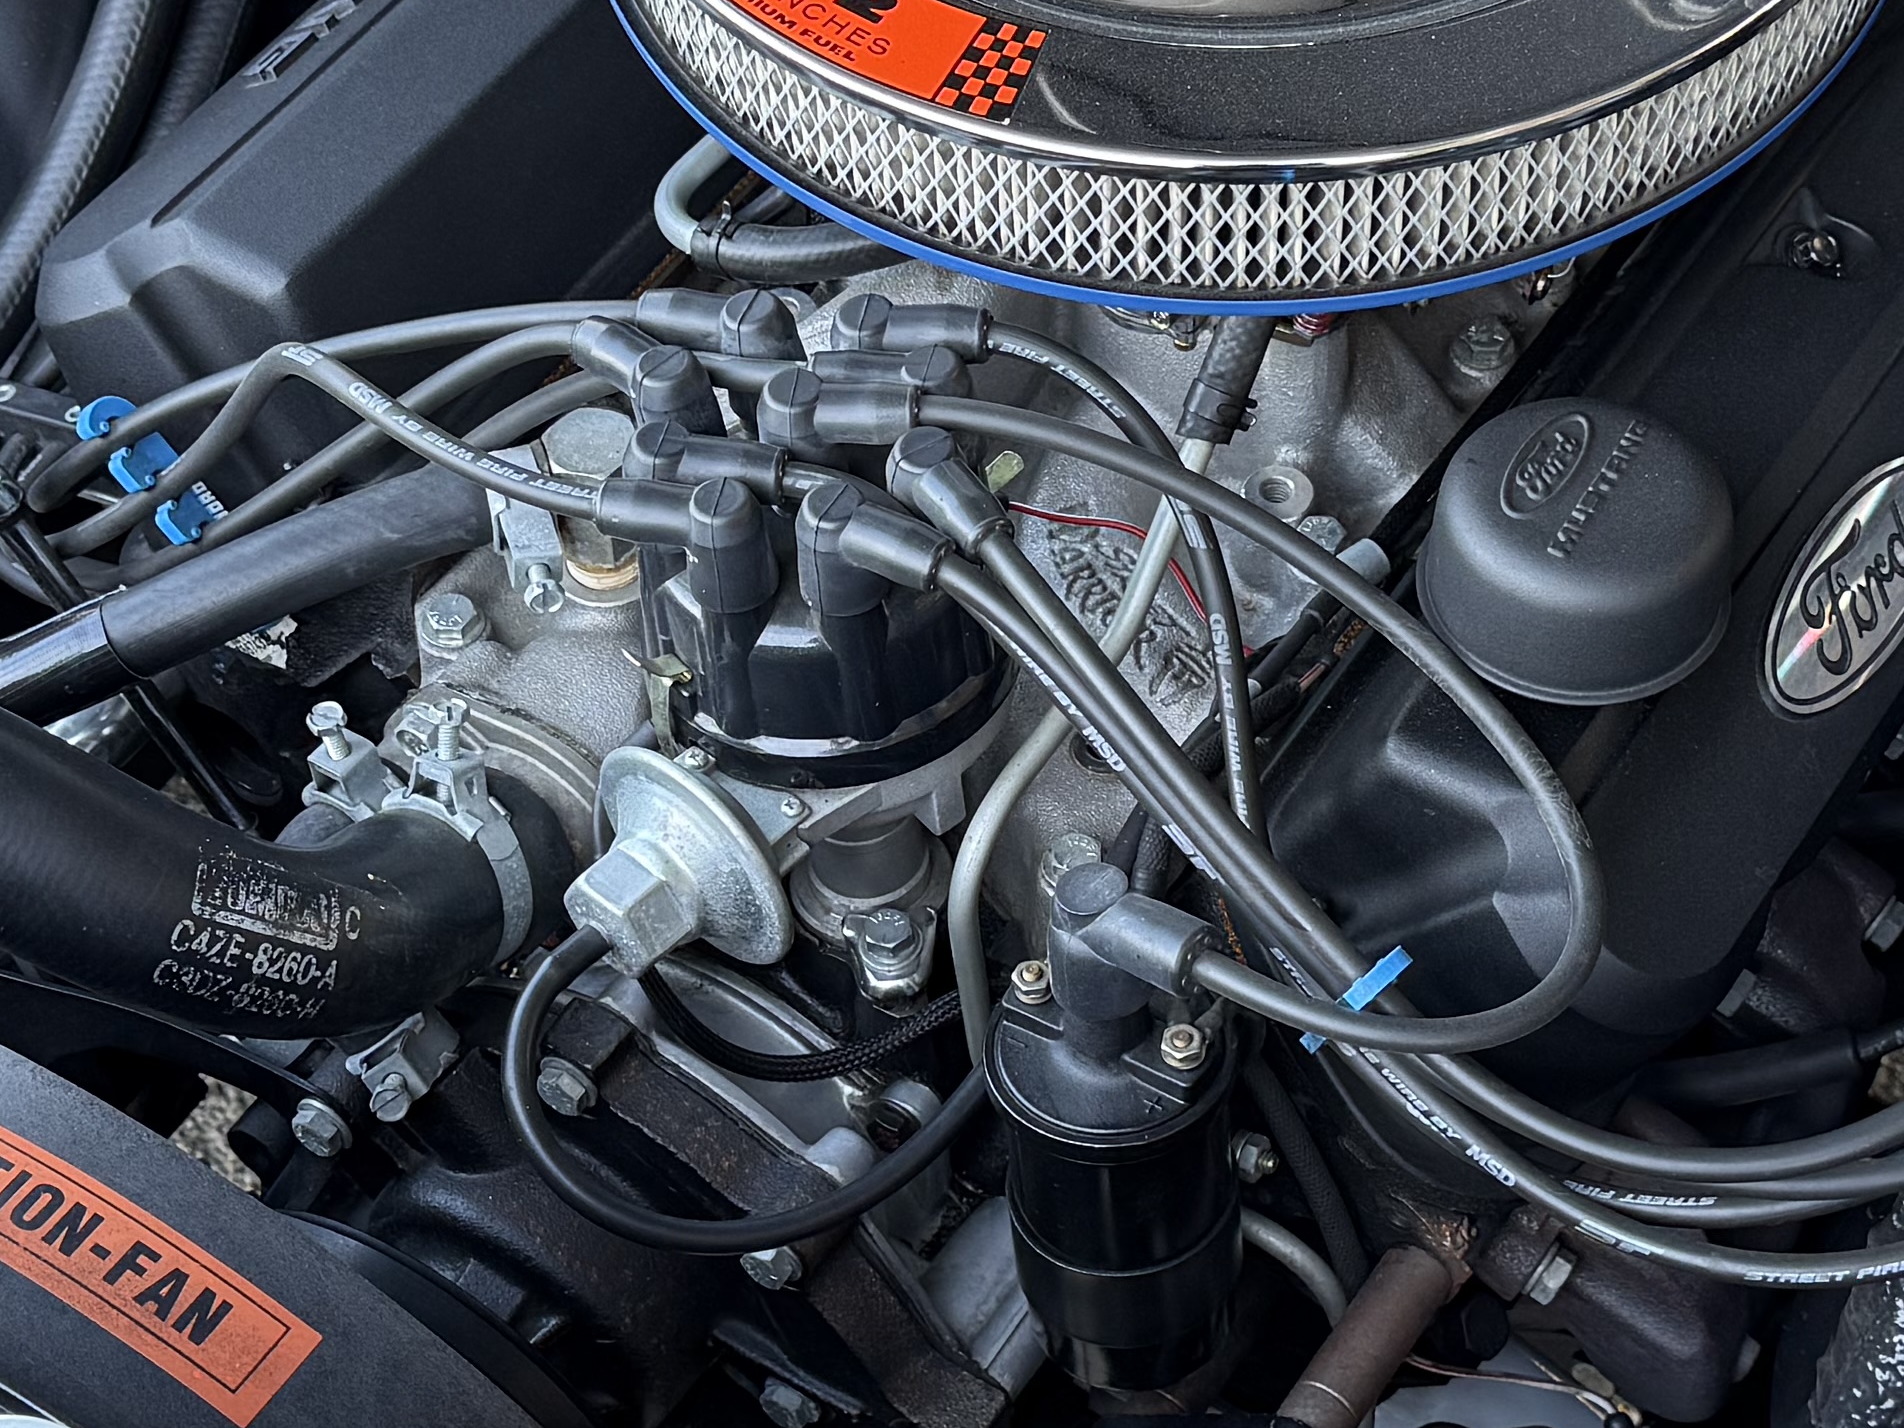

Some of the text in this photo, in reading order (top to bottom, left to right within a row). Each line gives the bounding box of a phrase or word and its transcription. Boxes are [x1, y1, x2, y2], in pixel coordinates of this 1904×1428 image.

[799, 27, 857, 63] FUEL
[348, 381, 394, 414] MSD
[392, 414, 424, 434] BY
[422, 430, 476, 462] WIRE
[475, 457, 530, 482] FIRE
[1515, 431, 1577, 501] Ford
[1209, 612, 1233, 666] MSD
[1082, 724, 1127, 773] MSD
[1226, 717, 1243, 773] WIRE
[170, 918, 339, 992] C4ZE-8260-A
[1381, 1067, 1430, 1113] WIRE
[1465, 1143, 1518, 1188] MSD
[1618, 1192, 1719, 1208] STREET
[1742, 1269, 1851, 1285] STREET
